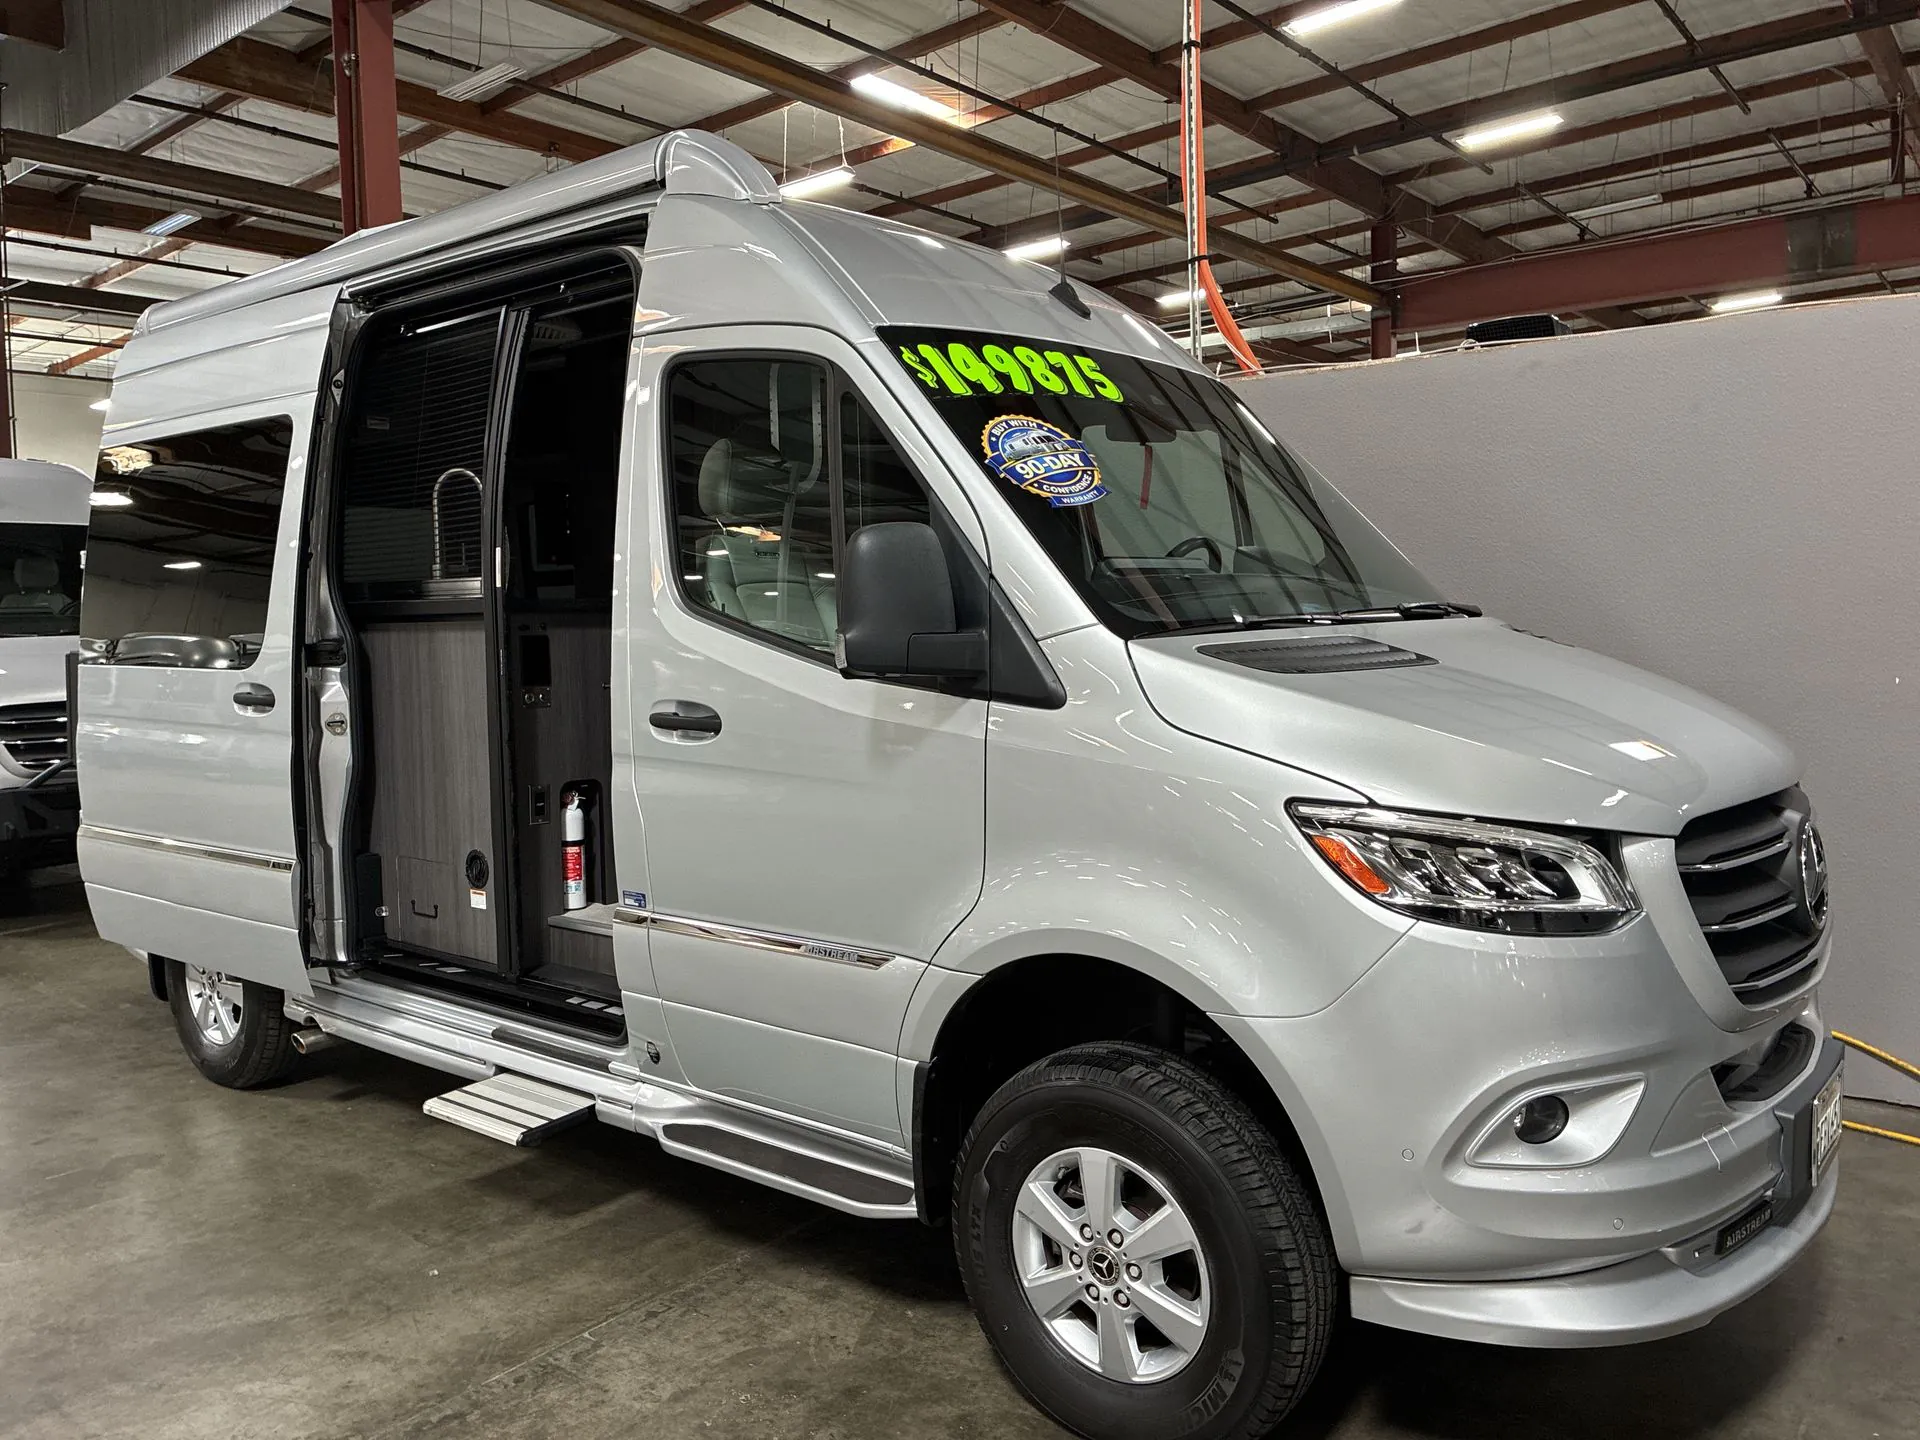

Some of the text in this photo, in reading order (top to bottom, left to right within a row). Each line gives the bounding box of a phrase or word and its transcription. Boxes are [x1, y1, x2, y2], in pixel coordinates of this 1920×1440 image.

[899, 343, 1124, 402] $149875
[991, 419, 1038, 436] BUY WITH
[1015, 453, 1085, 479] 90-DAY
[1042, 474, 1092, 494] CONFIDENCE
[1061, 490, 1099, 504] WARRANTY
[1726, 1208, 1770, 1248] AIRSTREAM
